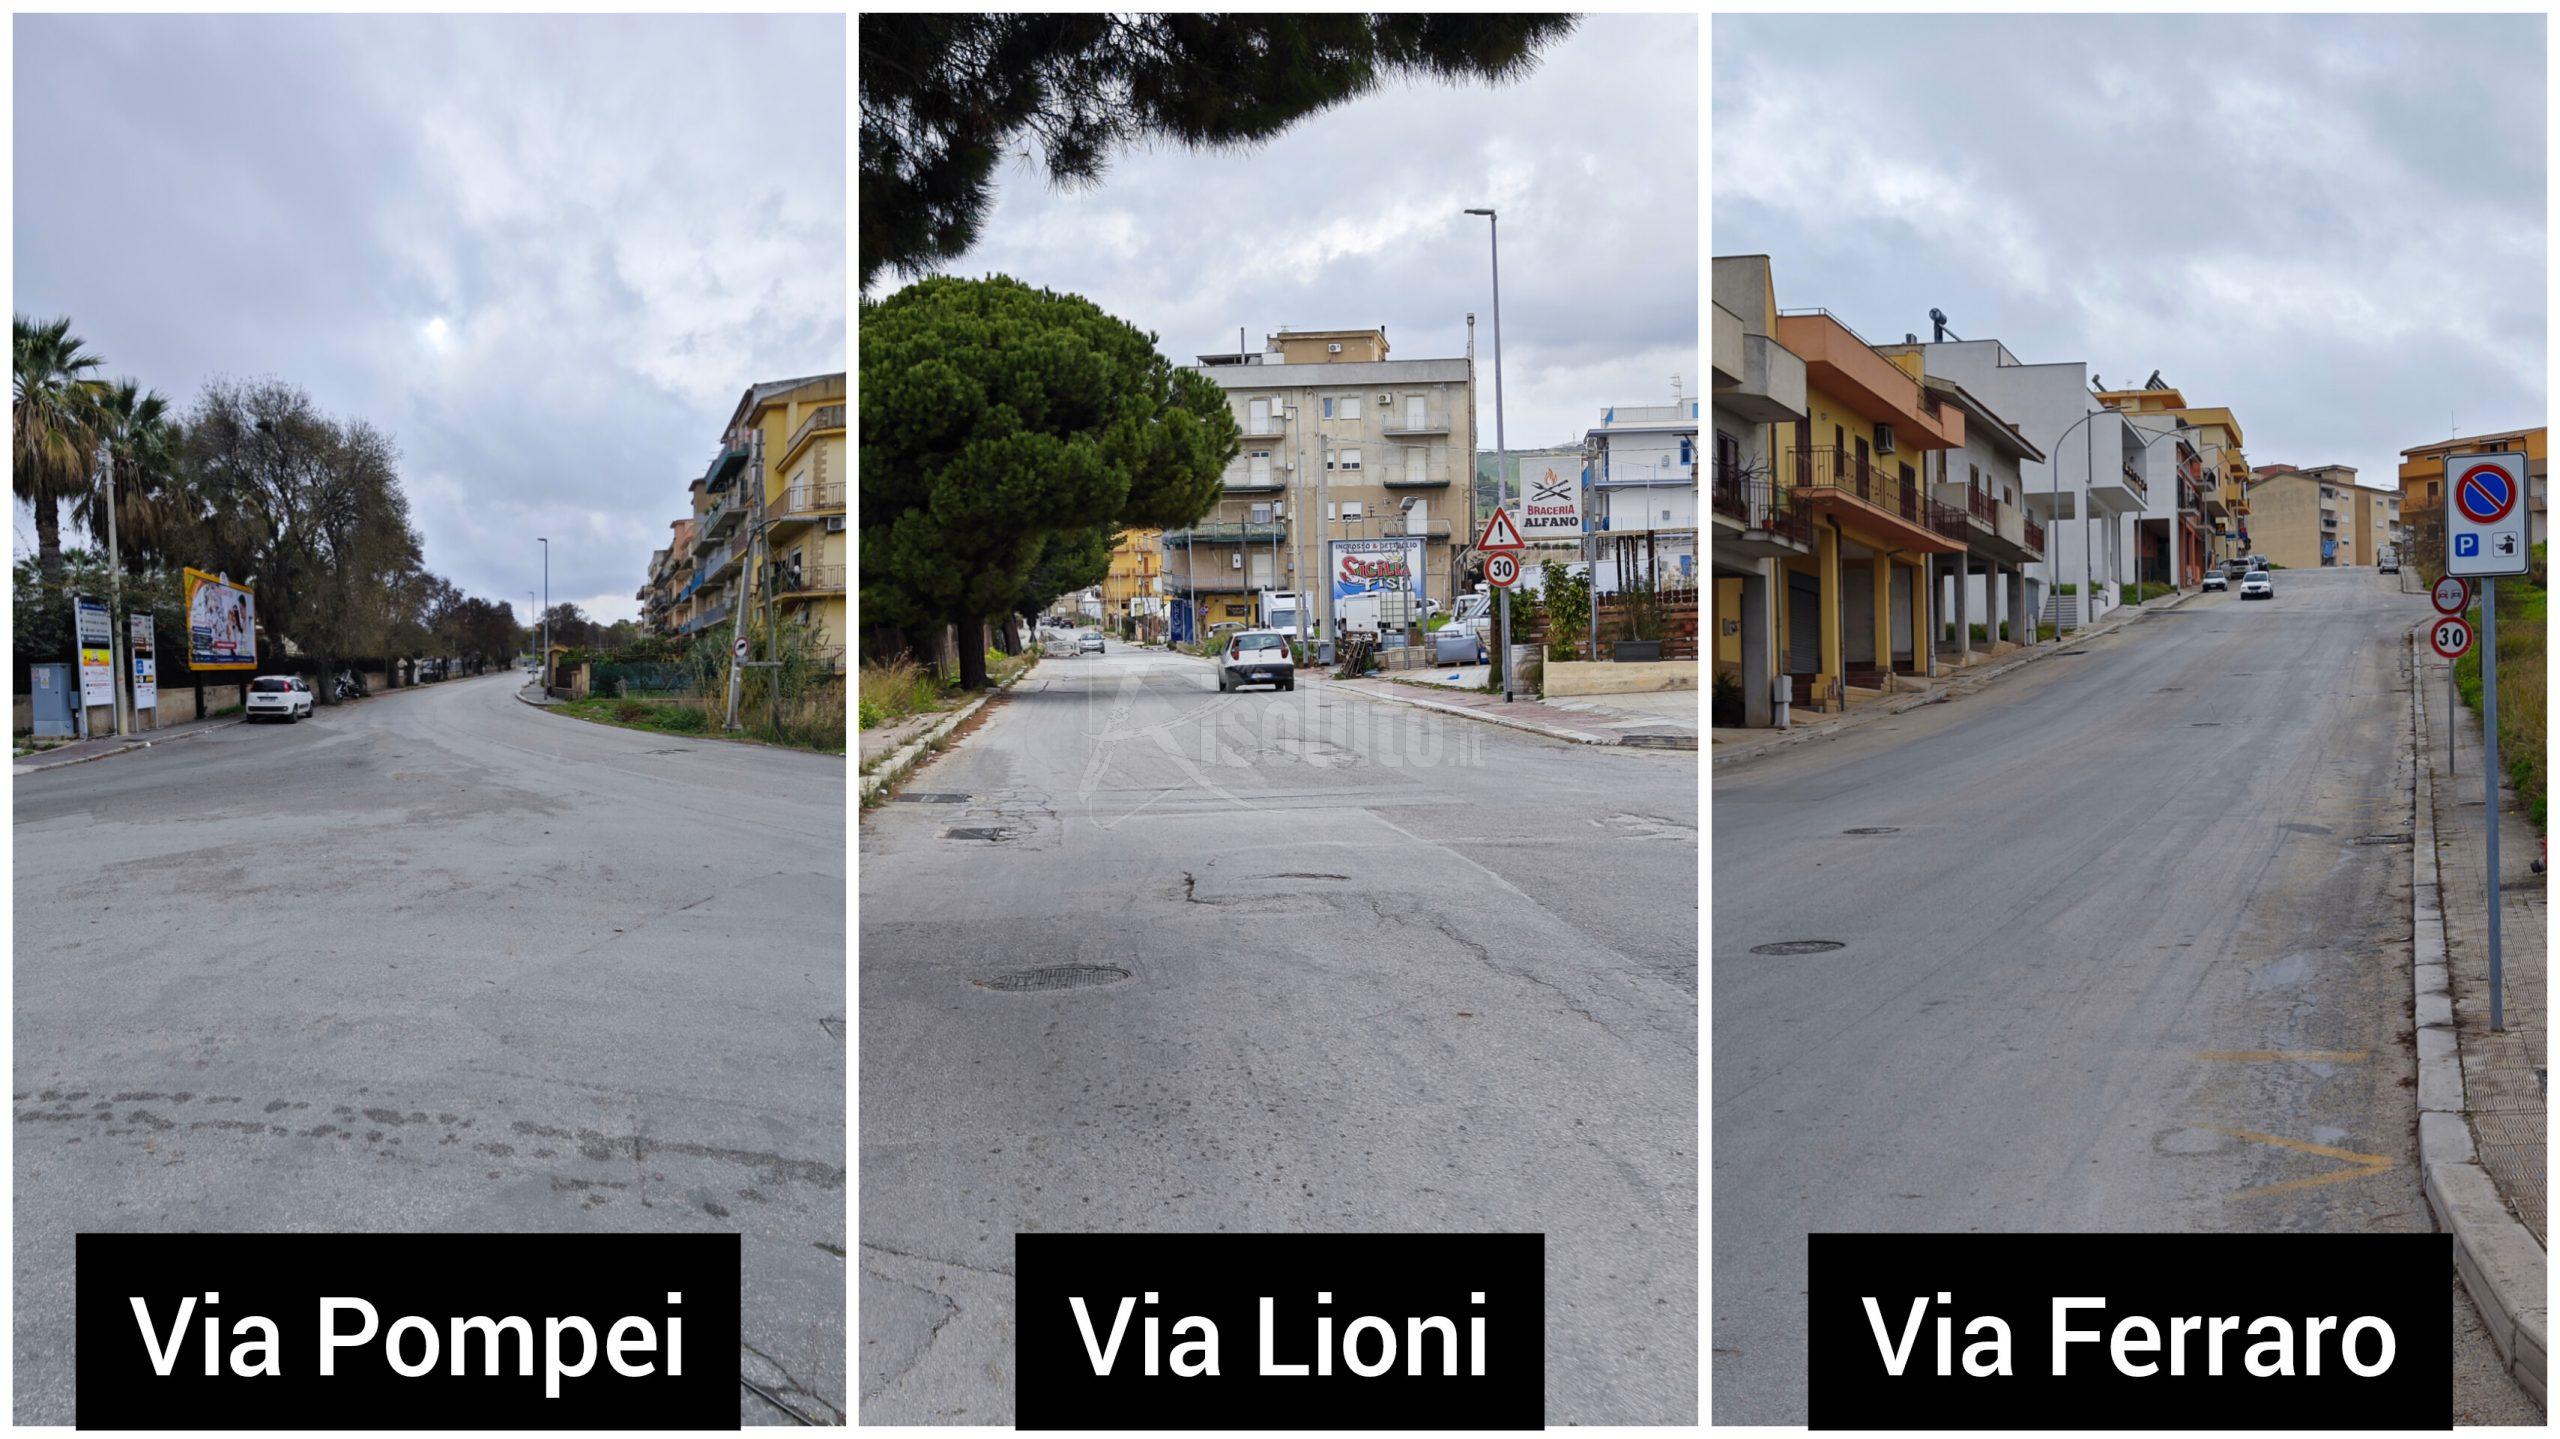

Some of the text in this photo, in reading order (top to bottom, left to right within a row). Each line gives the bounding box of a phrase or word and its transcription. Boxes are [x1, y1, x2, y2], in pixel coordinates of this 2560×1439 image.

[1527, 504, 1575, 515] BRACERIA
[1524, 516, 1579, 527] ALFANO
[2460, 536, 2474, 554] P
[1493, 560, 1512, 577] 30
[2438, 627, 2464, 647] 30
